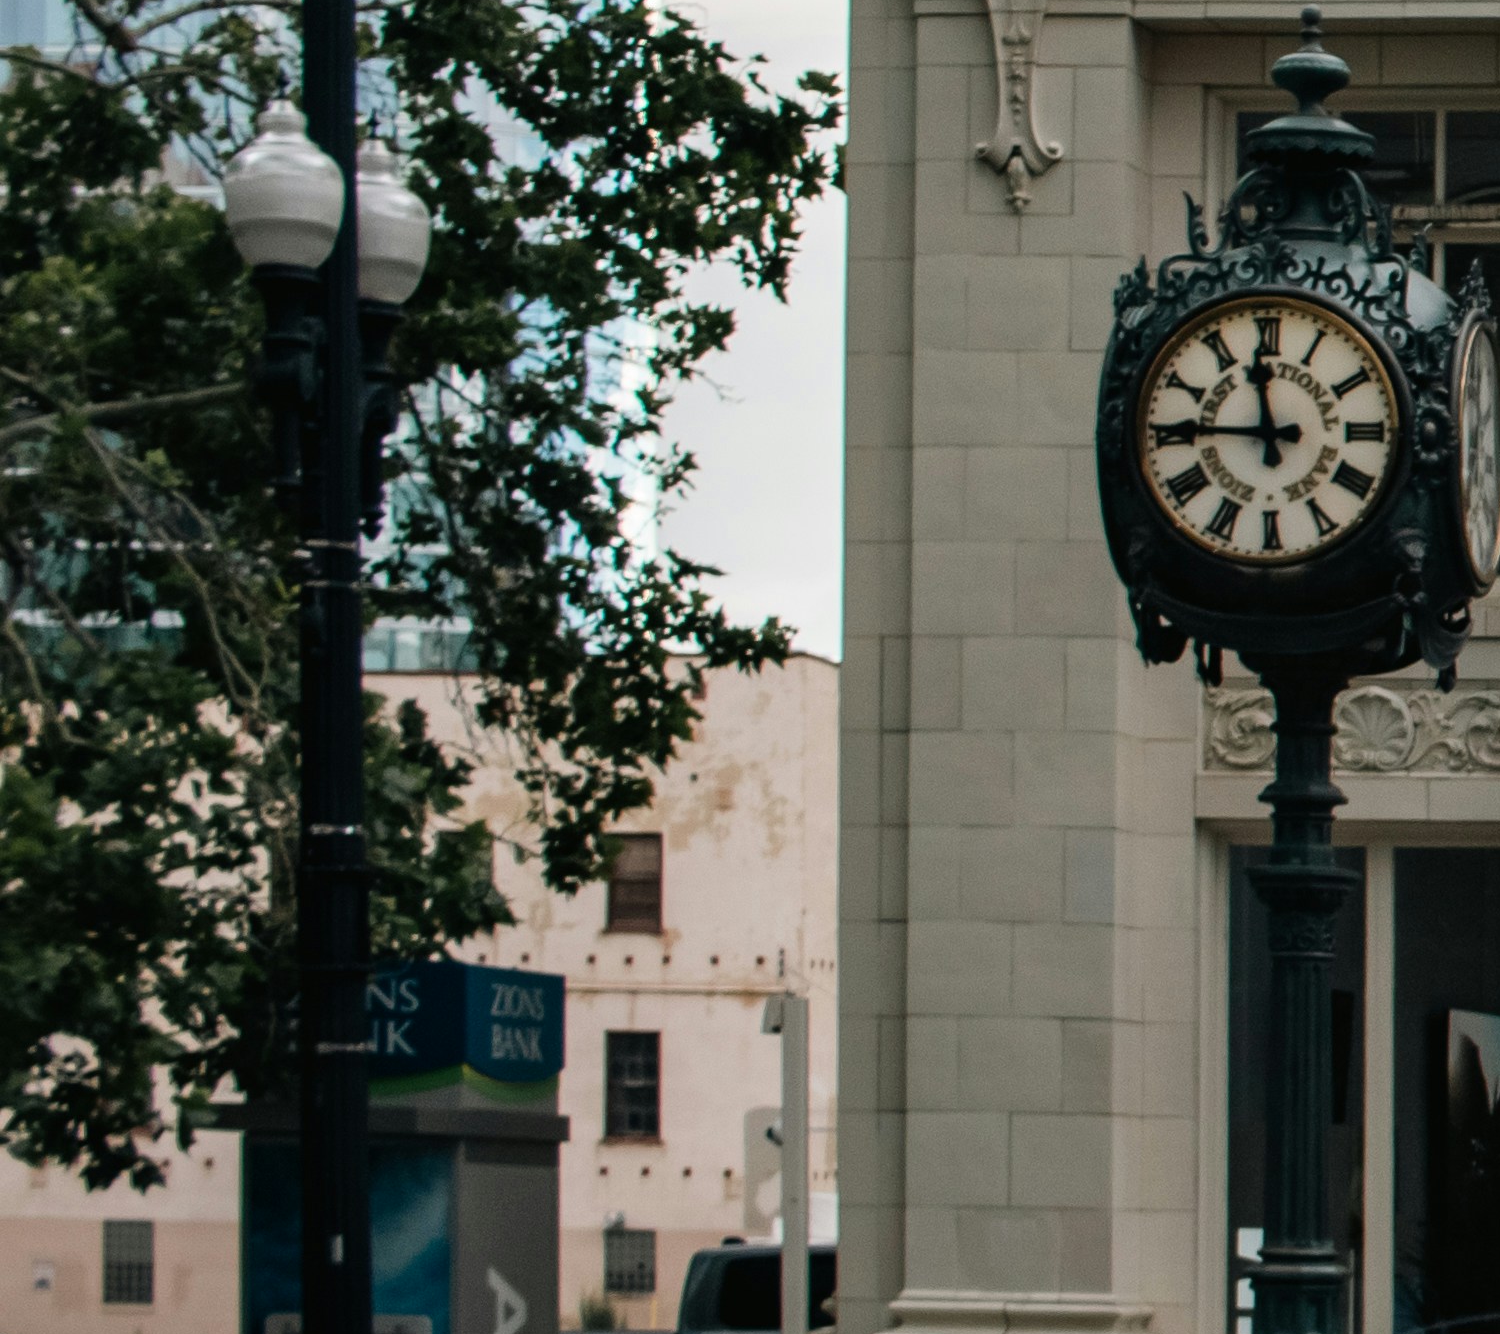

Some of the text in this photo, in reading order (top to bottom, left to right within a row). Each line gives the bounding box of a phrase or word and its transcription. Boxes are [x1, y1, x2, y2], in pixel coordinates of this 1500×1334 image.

[1301, 329, 1327, 366] I
[1331, 365, 1371, 401] II
[1201, 361, 1340, 504] ZIONS IRST TIONAL BANK
[1344, 421, 1386, 444] III
[490, 983, 546, 1022] ZIONS
[490, 1022, 544, 1063] BANK
